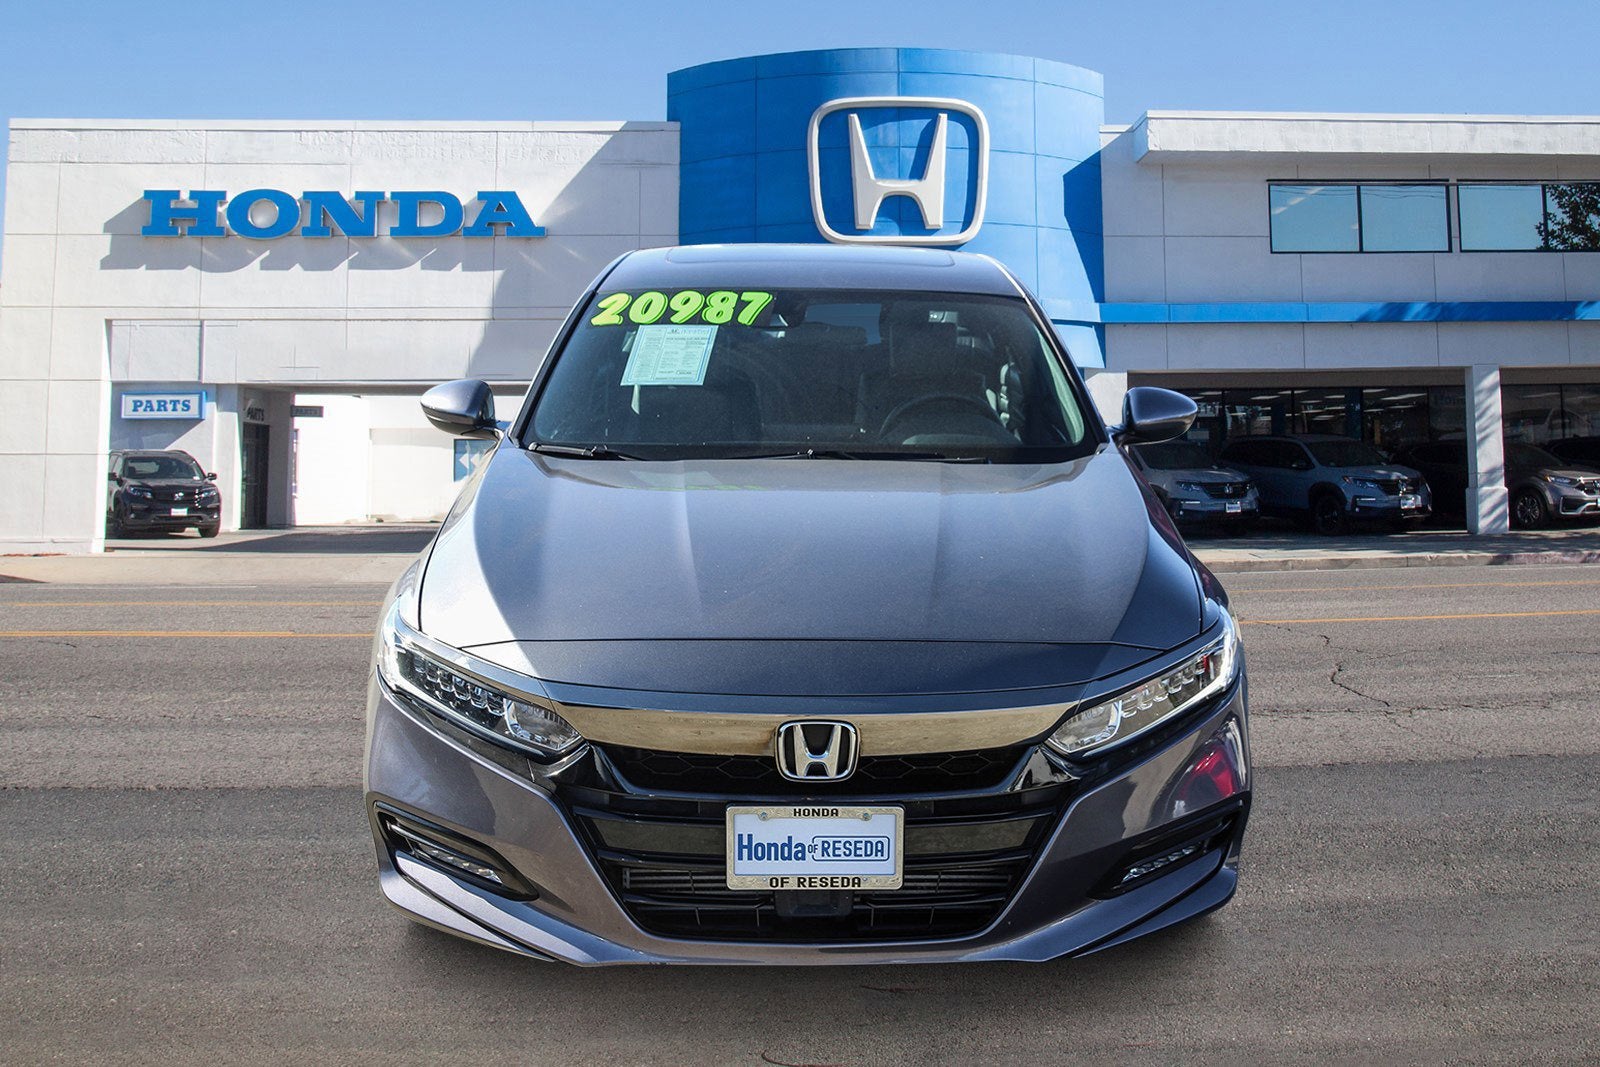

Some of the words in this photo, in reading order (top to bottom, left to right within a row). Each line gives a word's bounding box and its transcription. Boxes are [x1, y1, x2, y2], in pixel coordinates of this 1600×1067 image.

[141, 189, 548, 239] HONDA
[590, 290, 774, 327] 20987
[131, 399, 191, 412] PARTS
[793, 808, 839, 817] HONDA
[737, 833, 806, 861] Honda
[807, 844, 819, 854] OF
[821, 840, 885, 858] RESEDA
[769, 877, 790, 888] OF
[797, 877, 861, 888] RESEDA
